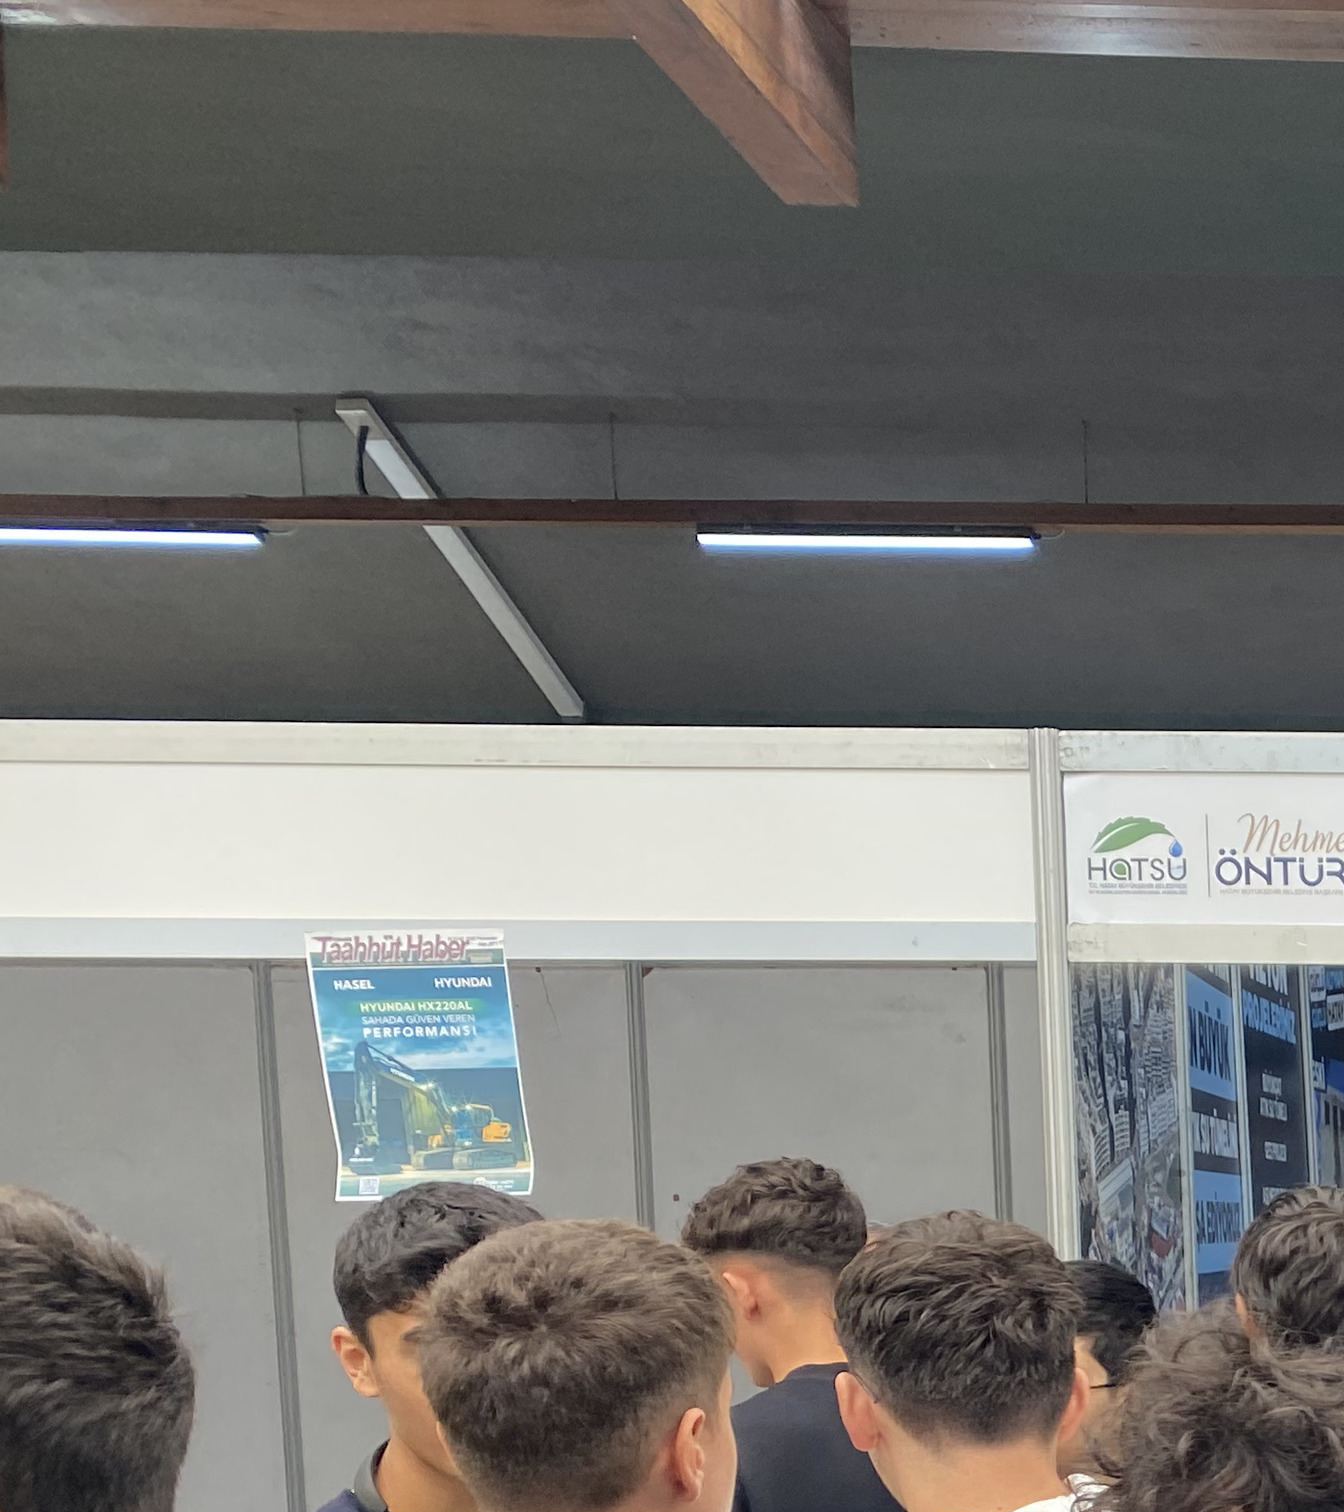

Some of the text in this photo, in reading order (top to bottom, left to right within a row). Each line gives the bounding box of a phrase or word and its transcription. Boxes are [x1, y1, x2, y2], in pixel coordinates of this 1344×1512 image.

[312, 935, 403, 964] Taahhüt
[406, 933, 470, 962] Haber
[333, 979, 375, 990] HASEL
[434, 977, 492, 988] HYUNDAI
[359, 1002, 415, 1013] HYUNDAI
[361, 1013, 476, 1026] SAHADA GÜVEN VEREN
[1198, 1001, 1231, 1081] BÜYÜK
